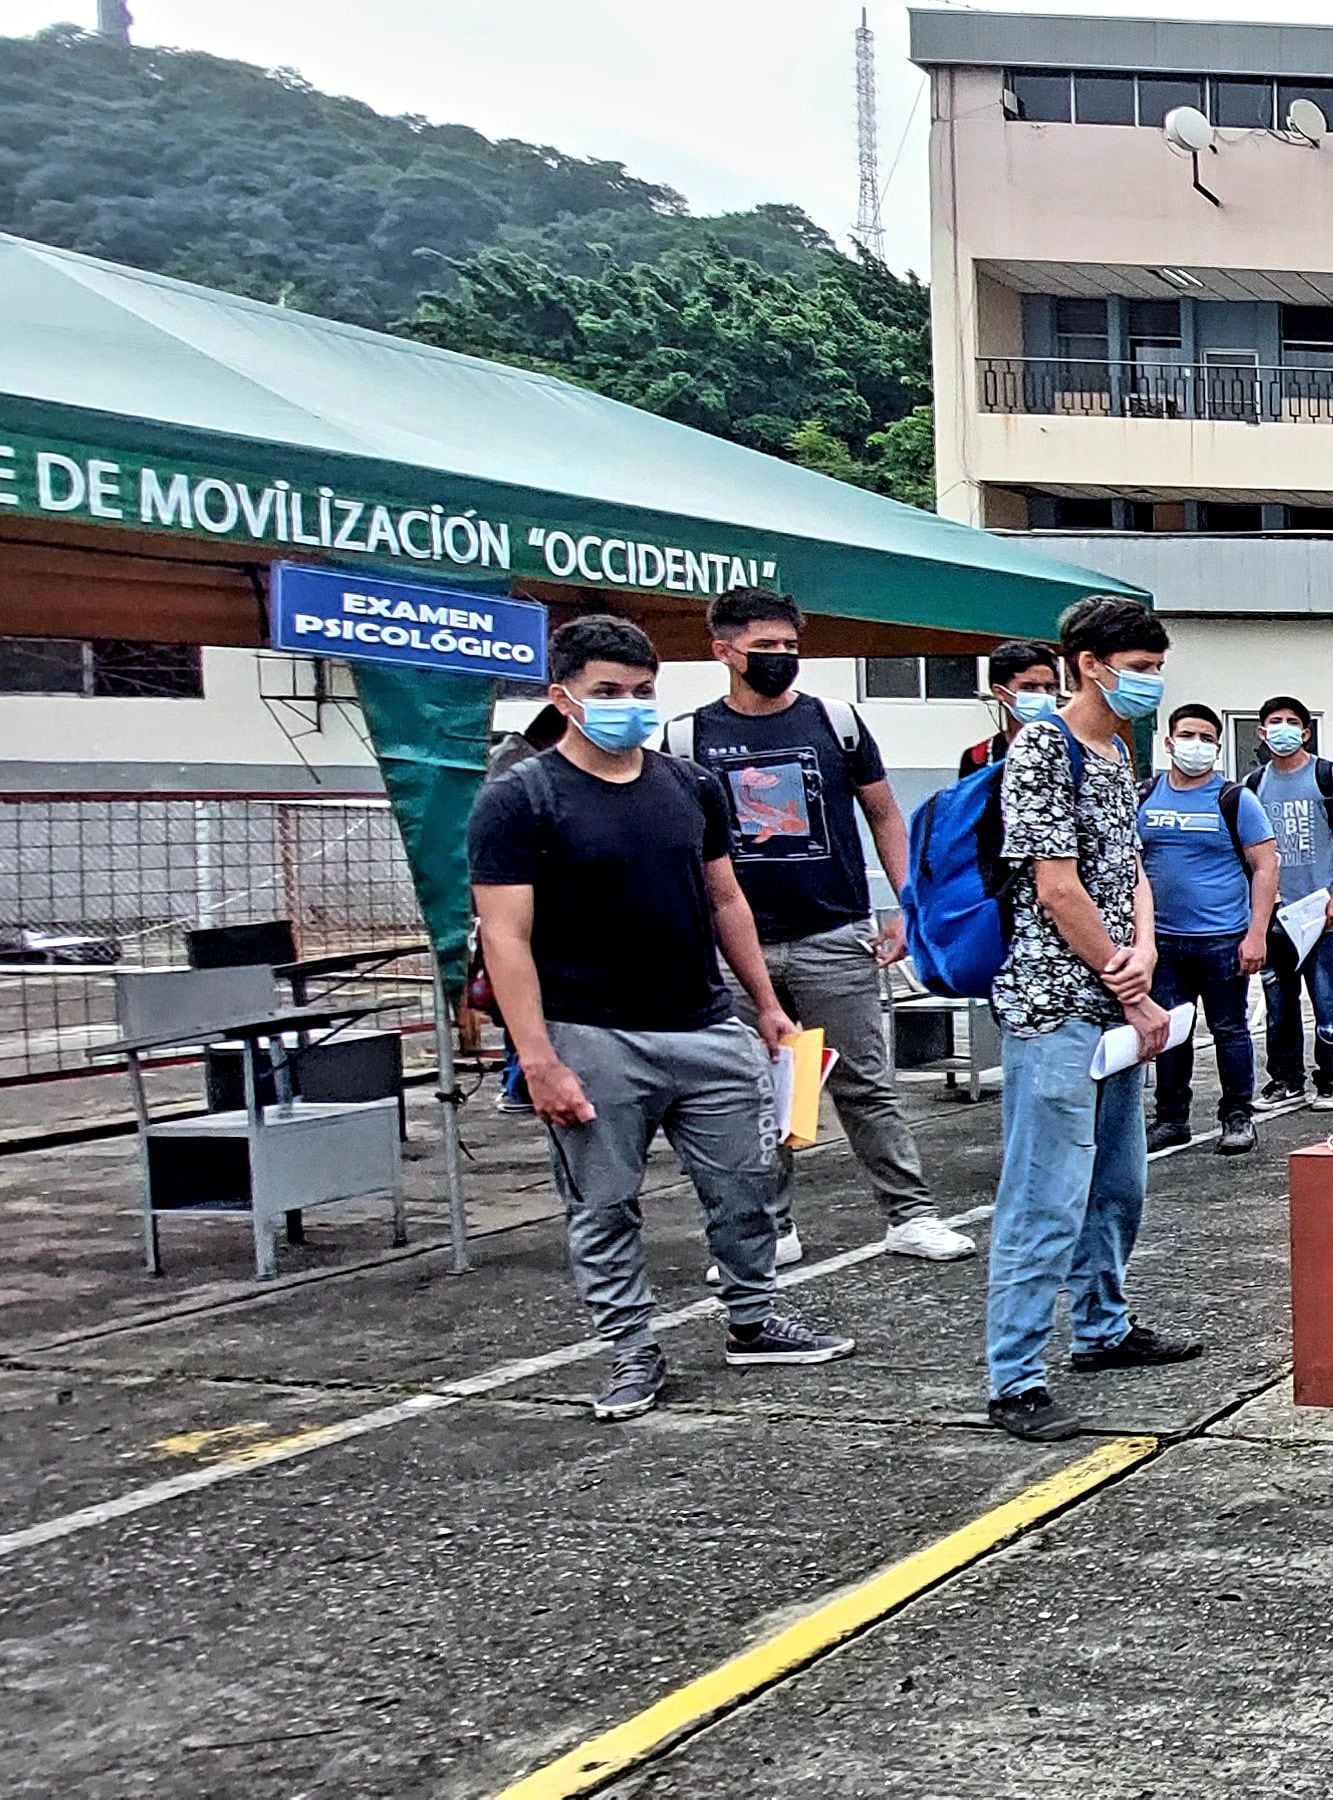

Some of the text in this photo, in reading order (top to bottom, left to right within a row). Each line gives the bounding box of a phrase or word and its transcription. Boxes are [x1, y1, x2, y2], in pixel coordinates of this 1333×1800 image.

[37, 451, 123, 520] DE
[342, 592, 494, 633] EXAMEN
[294, 614, 536, 664] PSICOLÓGICO
